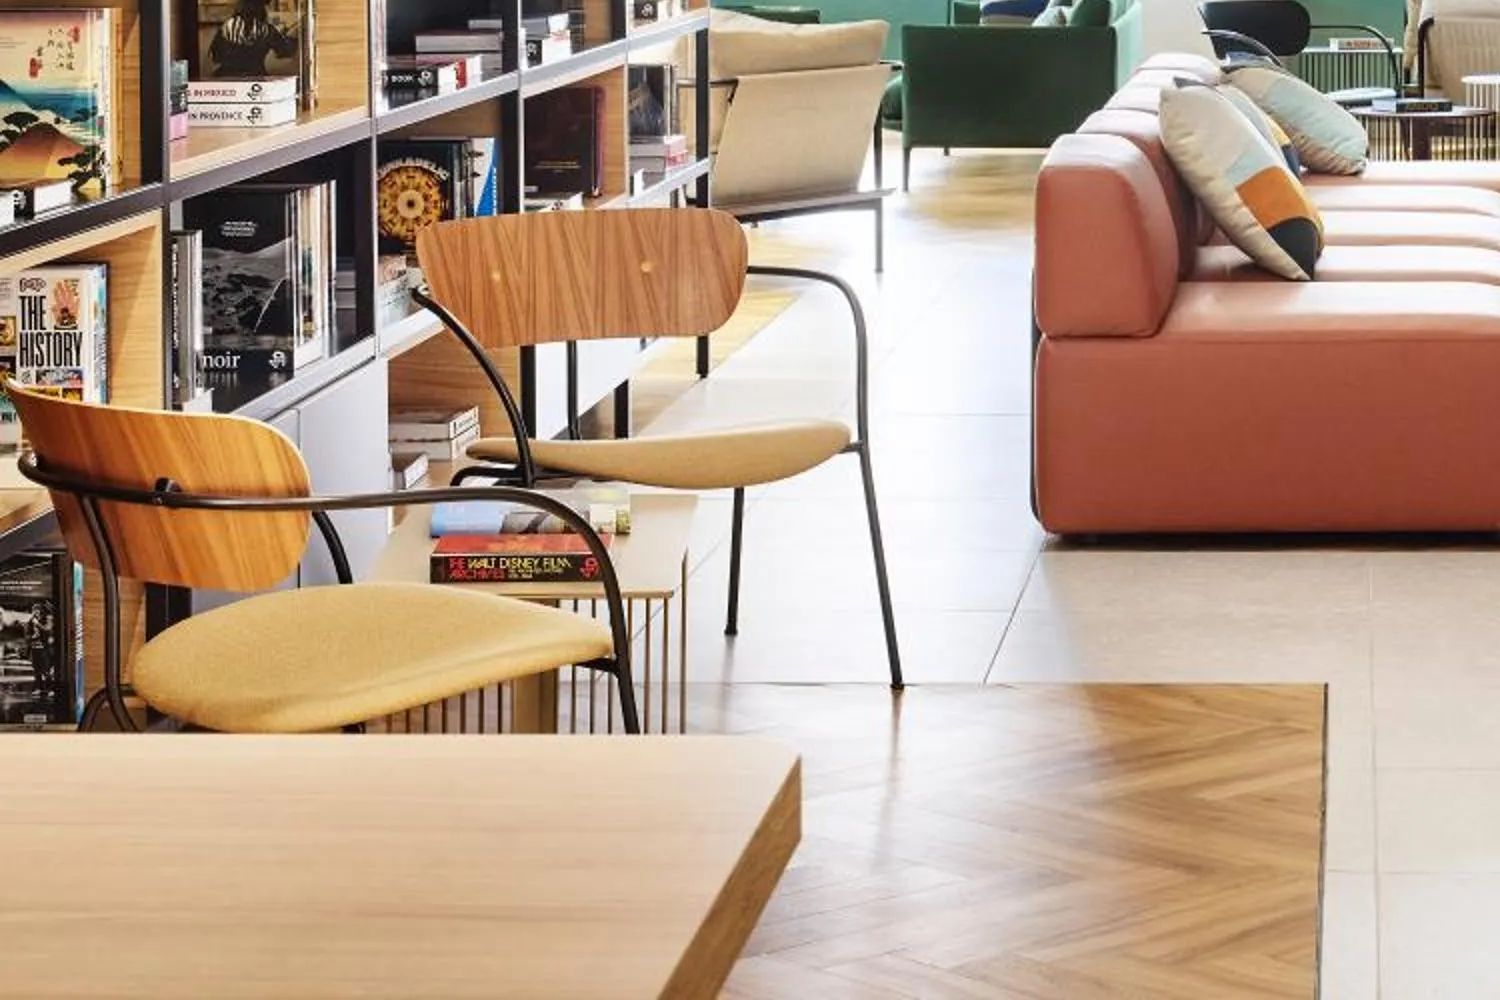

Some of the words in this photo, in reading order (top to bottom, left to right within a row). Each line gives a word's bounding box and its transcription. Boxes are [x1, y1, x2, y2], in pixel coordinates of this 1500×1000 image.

[200, 111, 243, 121] PROVENCE
[19, 295, 46, 331] THE
[19, 331, 83, 367] HISTORY
[203, 351, 241, 369] noir
[468, 558, 496, 569] WALT
[500, 557, 541, 569] DISNEY
[543, 557, 573, 569] FILM
